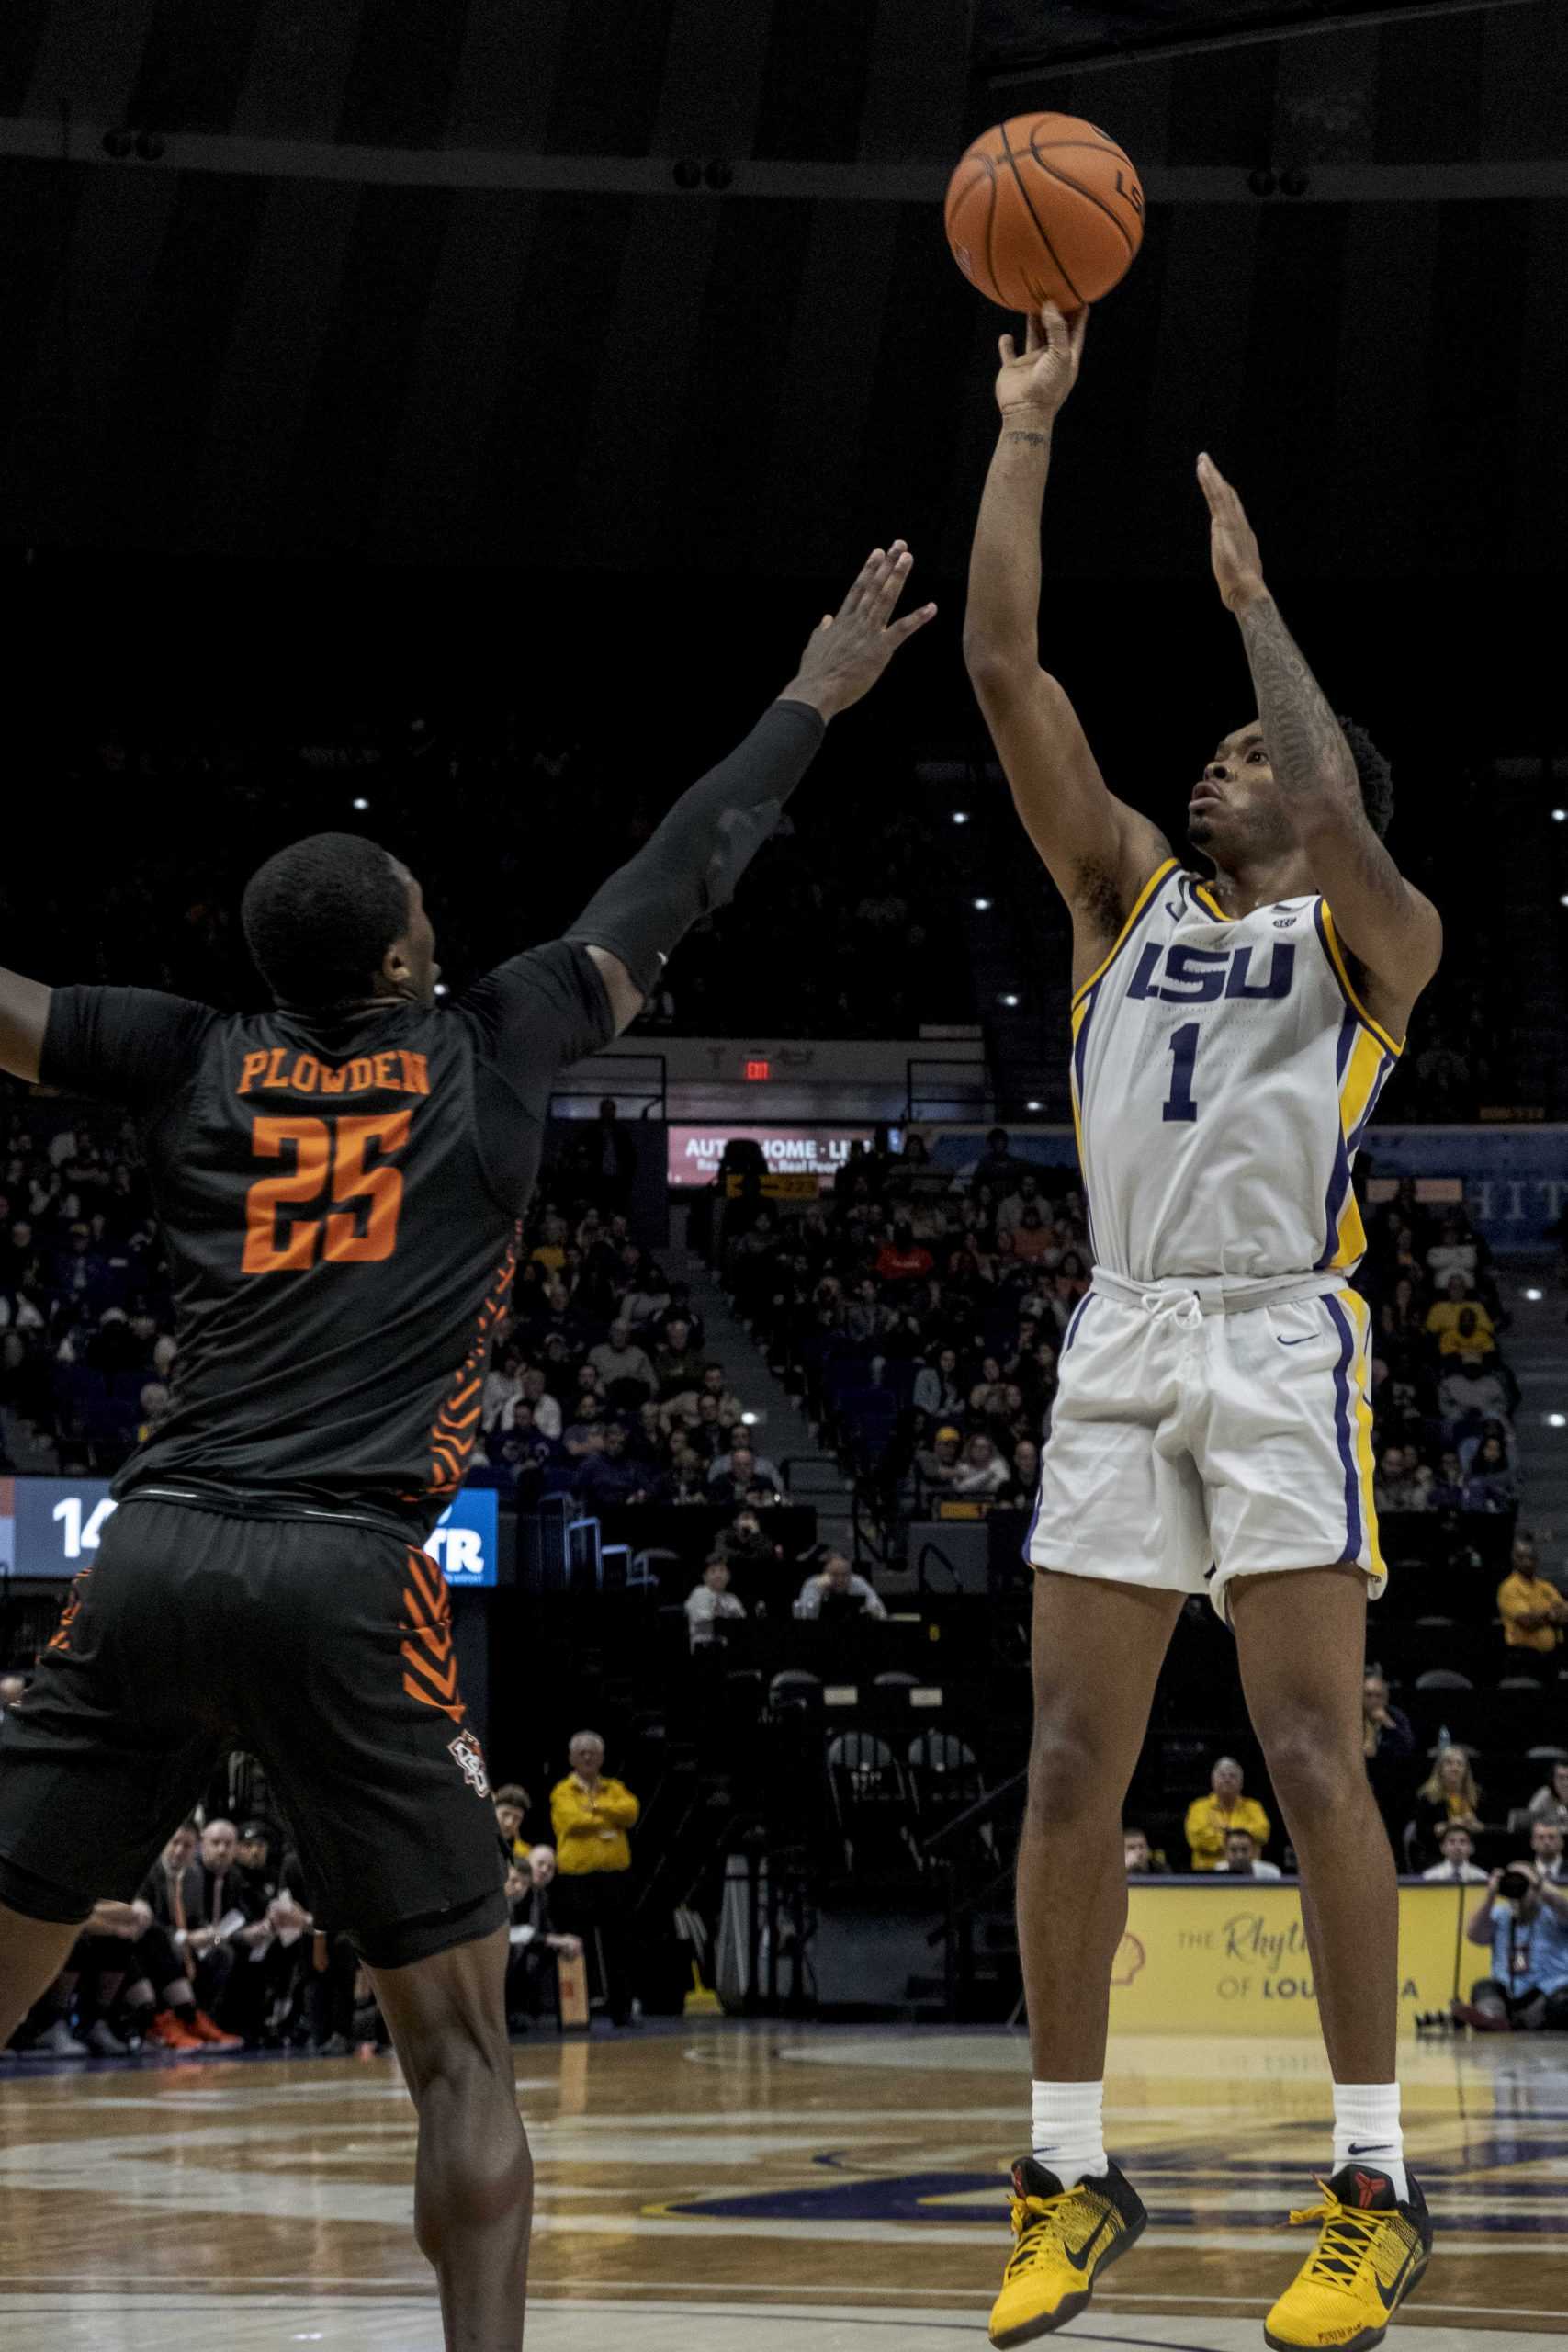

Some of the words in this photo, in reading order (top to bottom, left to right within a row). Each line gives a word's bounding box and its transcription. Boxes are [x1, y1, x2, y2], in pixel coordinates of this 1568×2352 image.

[1125, 941, 1296, 1003] LSU
[236, 1047, 431, 1095] PLOWDEN
[1162, 1023, 1201, 1122] 1
[685, 1139, 726, 1159] AUT
[241, 1109, 412, 1274] 25
[1179, 1932, 1213, 1950] THE
[1217, 1978, 1251, 2000] OF
